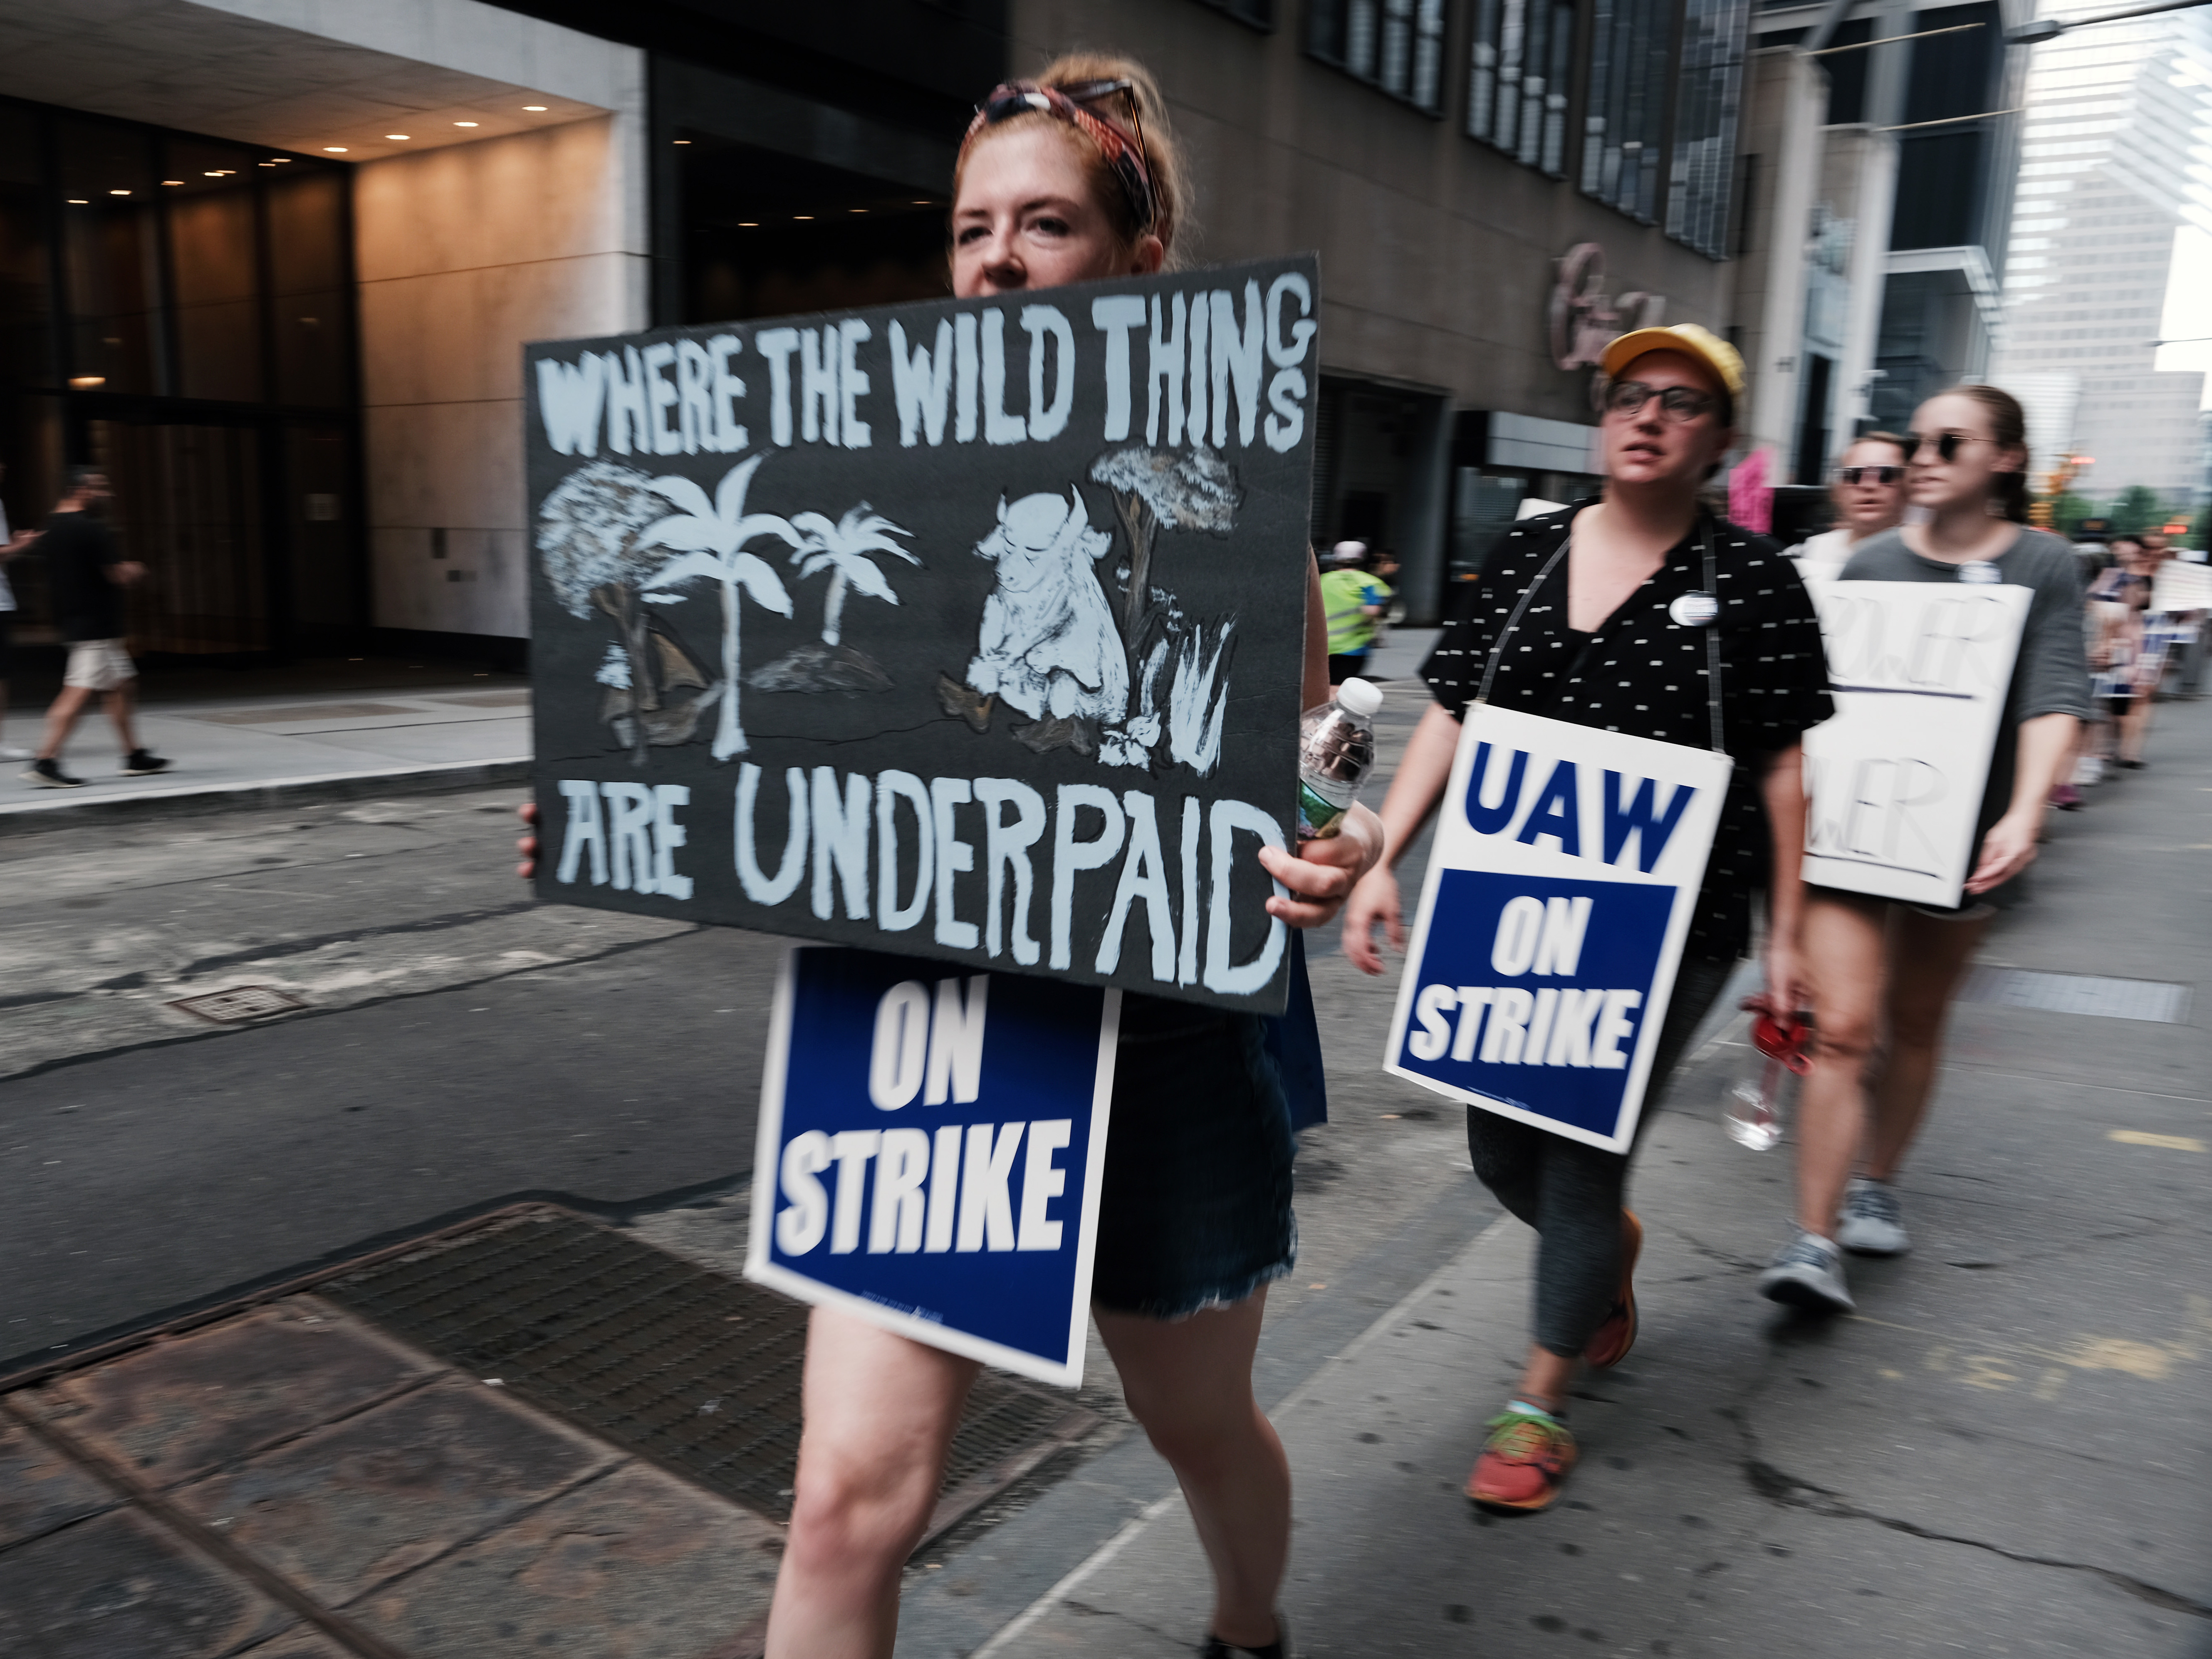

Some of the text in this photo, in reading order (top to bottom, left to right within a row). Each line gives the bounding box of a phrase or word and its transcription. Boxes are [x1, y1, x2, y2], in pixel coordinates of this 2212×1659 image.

[535, 271, 1317, 458] WHERE THE WILD THINGS
[1465, 740, 1702, 875] UAW
[556, 761, 1290, 995] ARE UNDERPAID
[1490, 895, 1594, 977] ON
[868, 973, 990, 1112] ON
[1408, 983, 1643, 1070] STRIKE
[775, 1118, 1072, 1257] STRIKE
